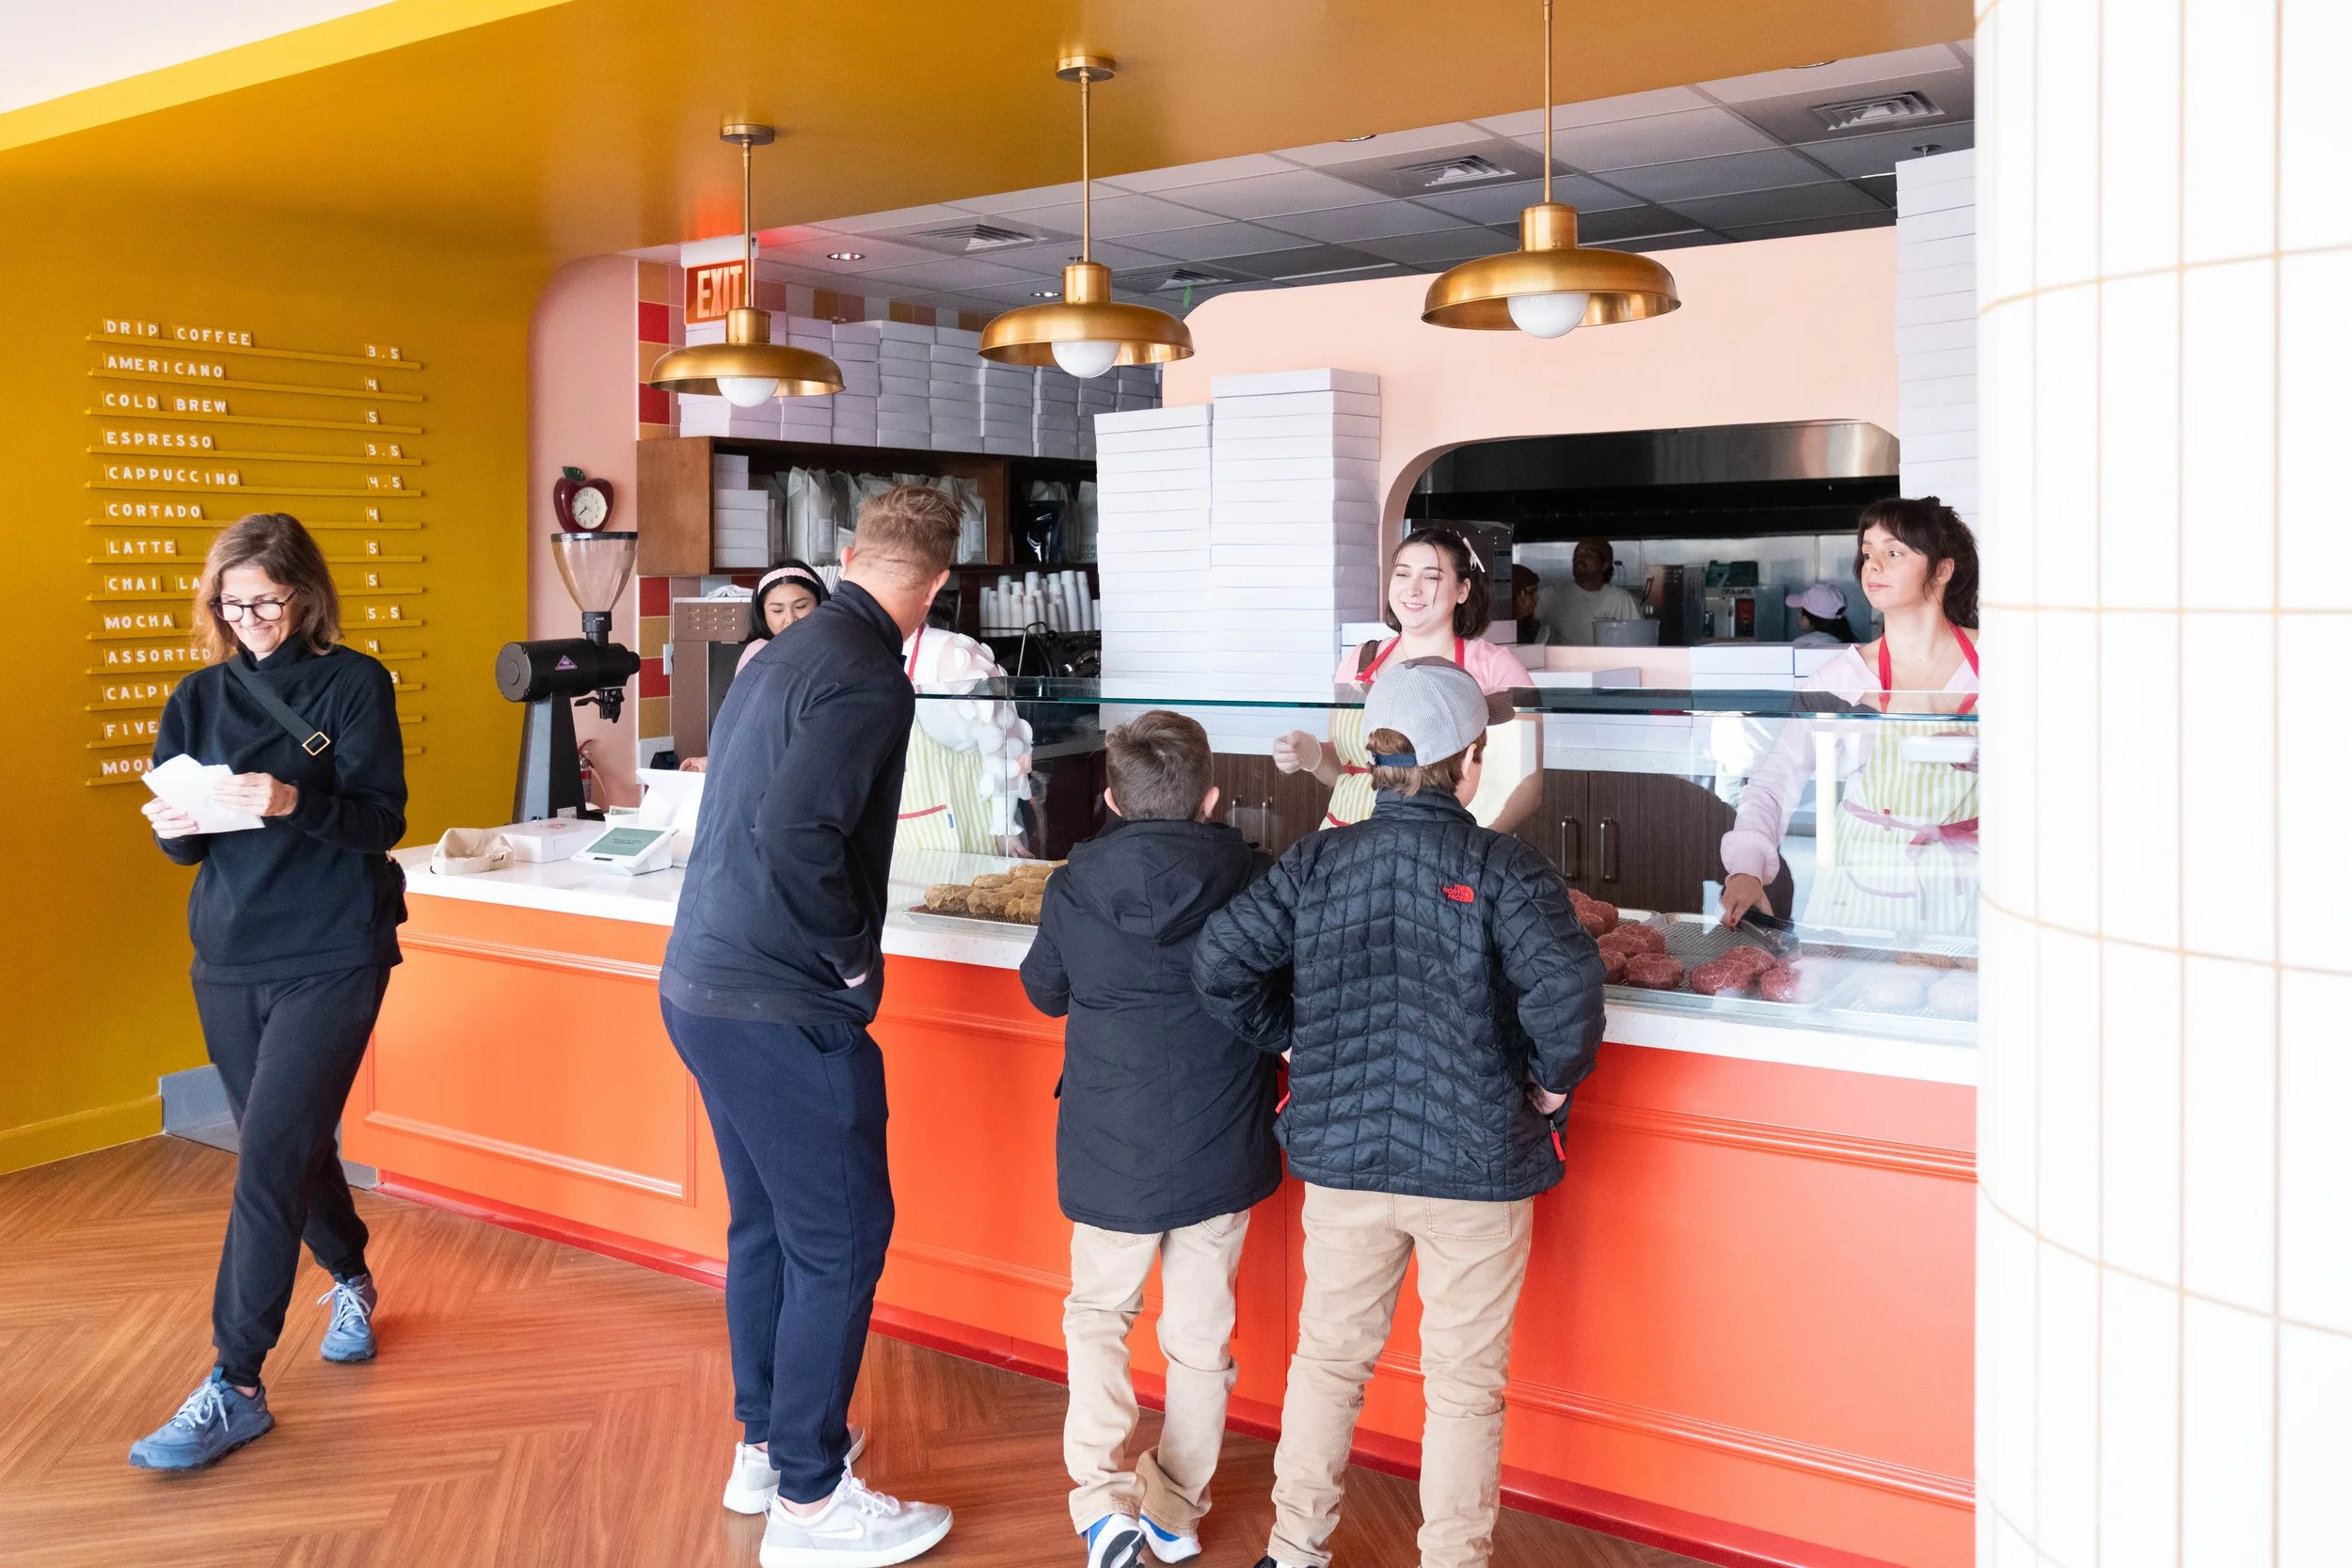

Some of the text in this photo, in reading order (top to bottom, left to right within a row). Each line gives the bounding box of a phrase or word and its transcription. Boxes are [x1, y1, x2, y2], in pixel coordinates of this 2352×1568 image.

[697, 264, 742, 318] EXIT
[106, 320, 399, 359] DRIP COFFEE 3.5
[107, 356, 377, 390] AMERICANO 4
[105, 393, 377, 423] COLD BREW 5
[106, 431, 399, 457] ESPRESSO 3.5
[108, 467, 400, 488] CAPPUCCINO 4.5
[108, 503, 377, 520] CORTADO 4
[109, 541, 377, 554] LATTE 5
[108, 578, 157, 591] CHAI
[369, 574, 377, 586] 5
[104, 614, 173, 629] MOCHA
[368, 607, 399, 620] 5.5
[108, 641, 377, 664] ASSORTED 4
[105, 684, 173, 701] CALPI
[105, 721, 159, 737] FIVE
